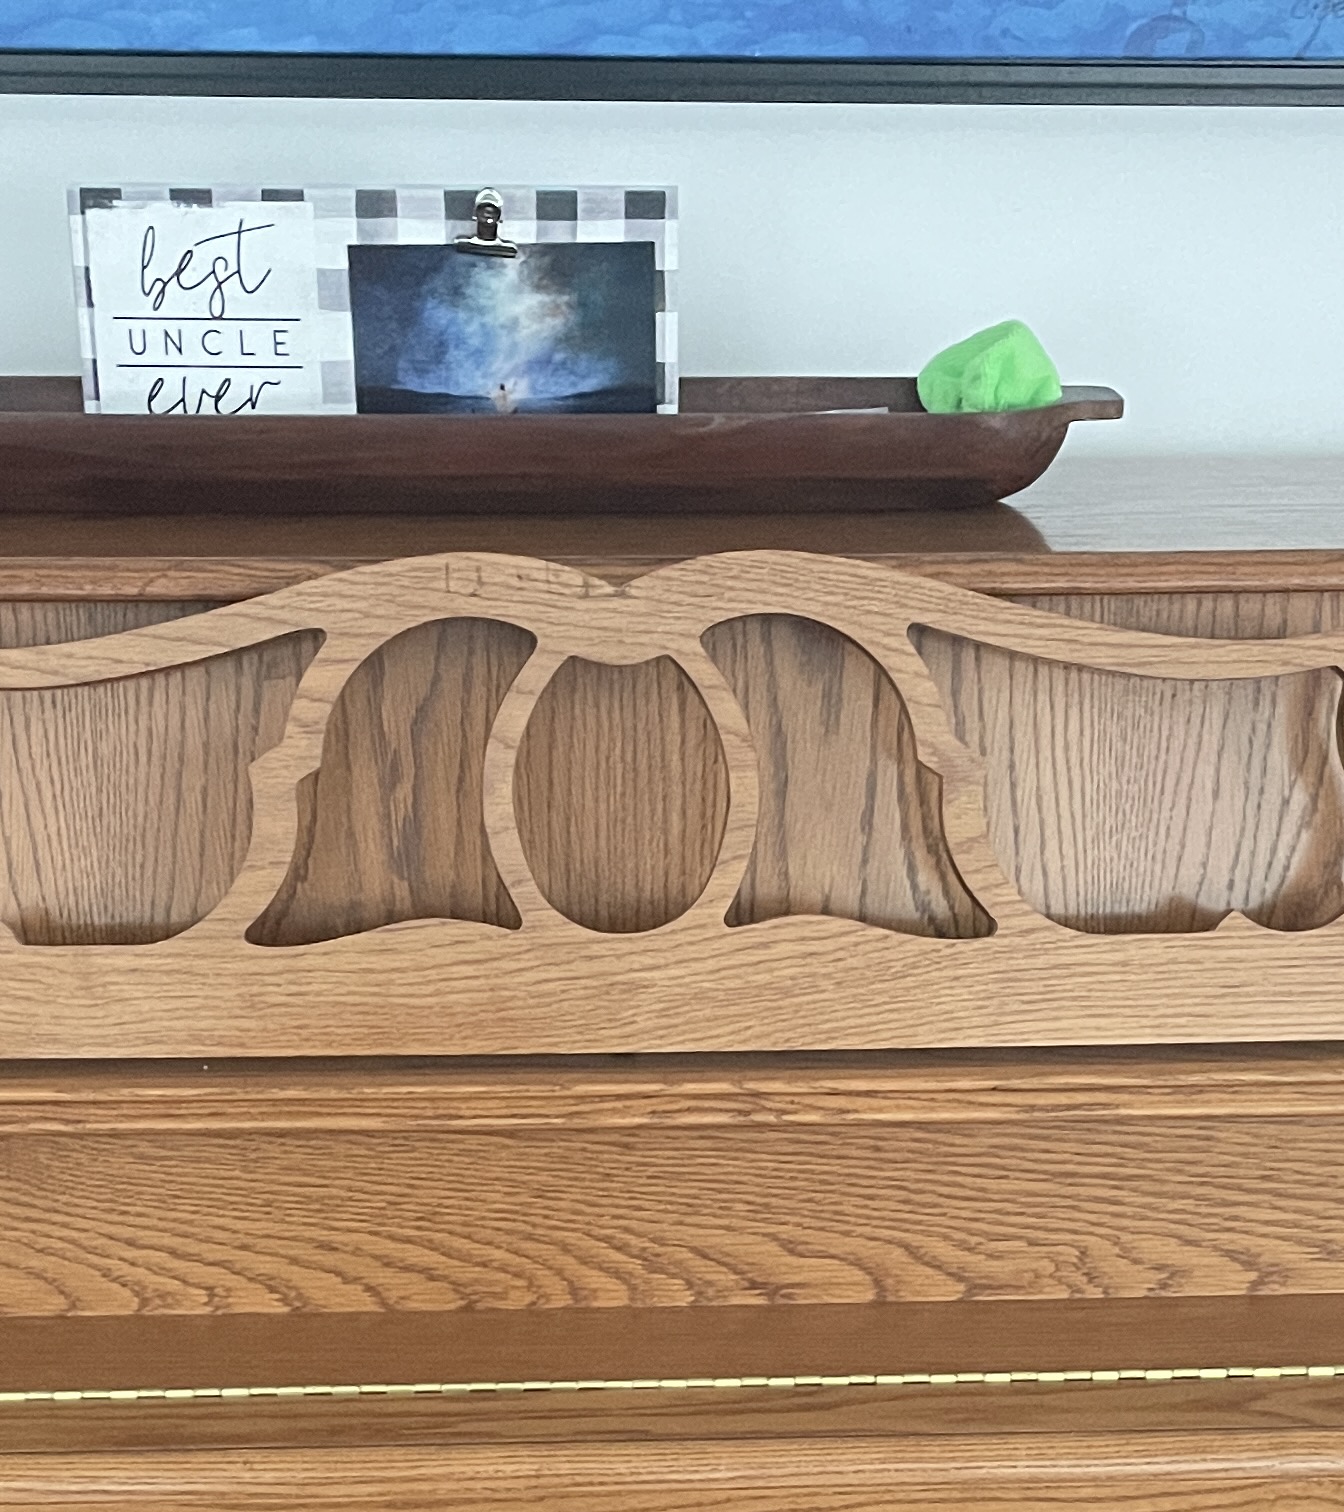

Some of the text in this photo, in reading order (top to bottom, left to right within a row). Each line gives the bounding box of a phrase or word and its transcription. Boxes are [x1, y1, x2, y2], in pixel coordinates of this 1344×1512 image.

[141, 218, 275, 320] best
[128, 328, 290, 356] UNCLE
[147, 376, 281, 414] ever
